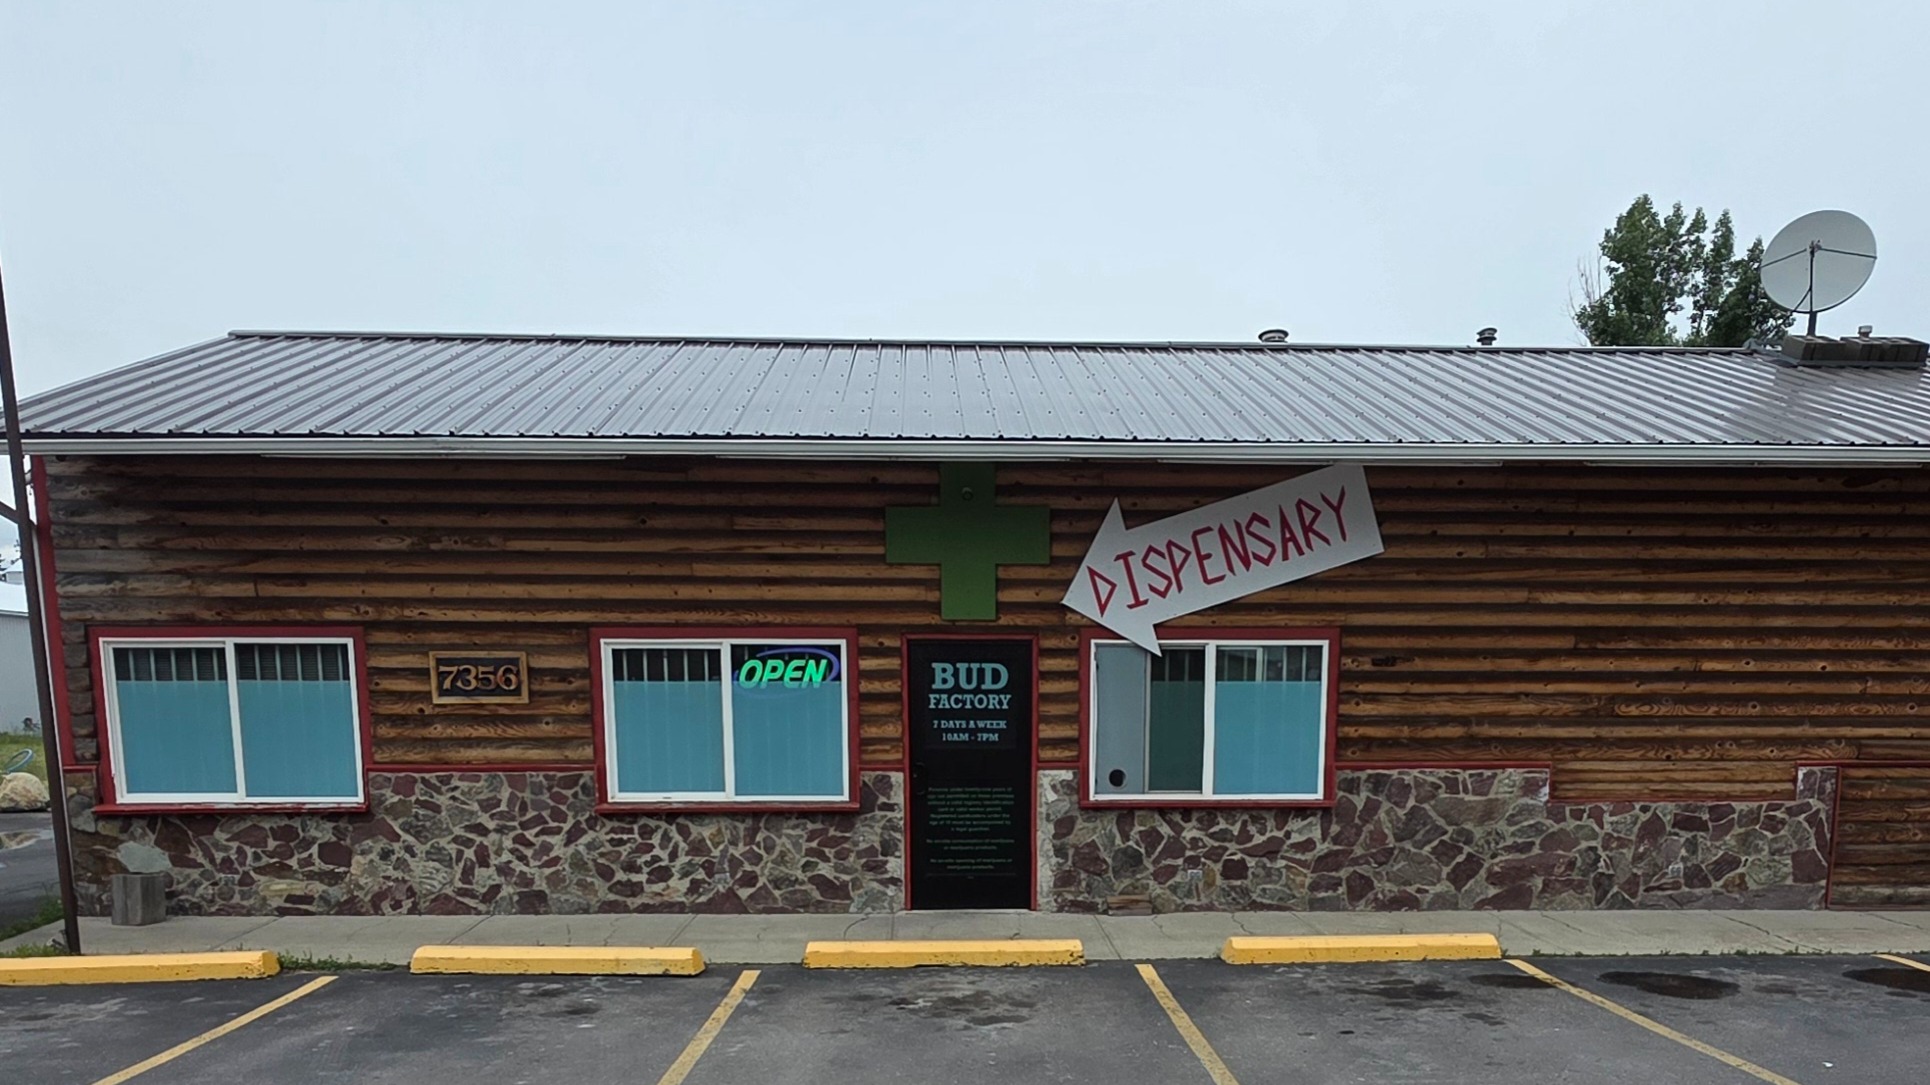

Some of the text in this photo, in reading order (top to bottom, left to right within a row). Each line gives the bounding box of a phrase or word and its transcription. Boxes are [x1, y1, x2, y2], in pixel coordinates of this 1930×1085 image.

[1086, 485, 1347, 618] DISPENSARY
[438, 664, 519, 691] 7356
[739, 658, 828, 690] OPEN
[931, 662, 1009, 690] BUD
[928, 693, 1012, 709] FACTORY
[932, 720, 1007, 729] 7 DAYS A WEEK
[942, 733, 969, 742] 10AM
[976, 733, 999, 742] 7PM
